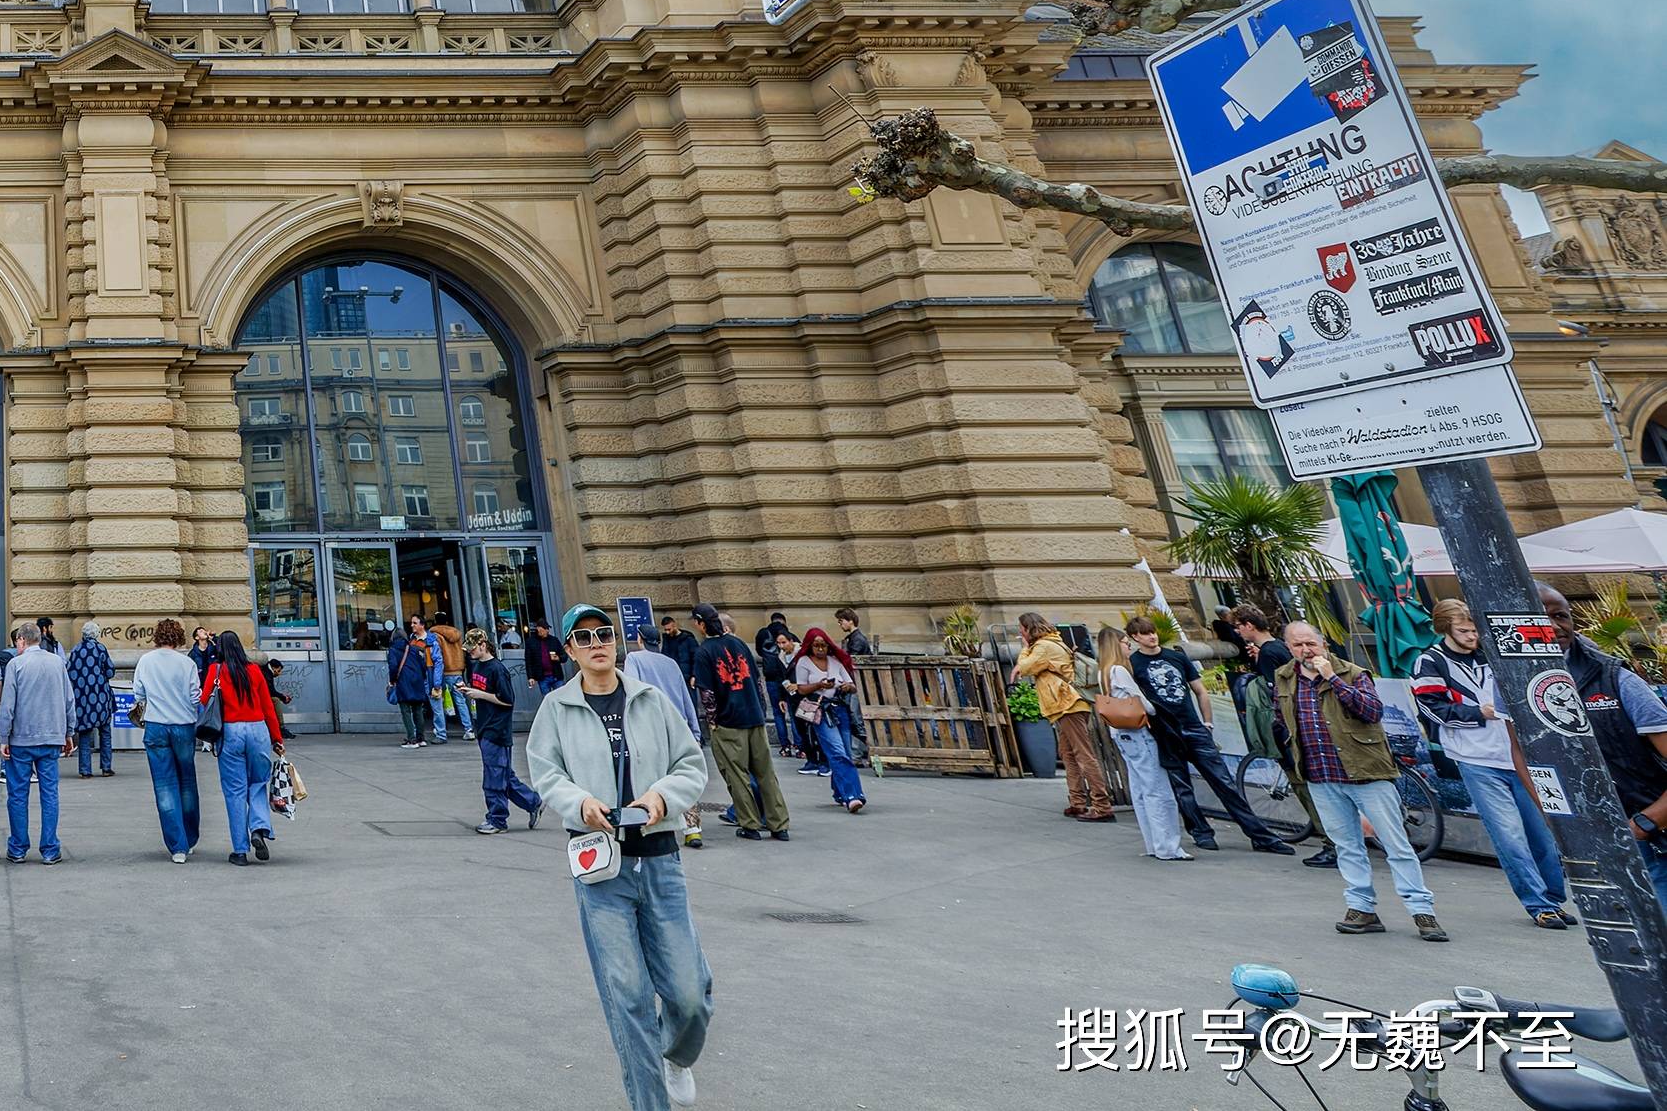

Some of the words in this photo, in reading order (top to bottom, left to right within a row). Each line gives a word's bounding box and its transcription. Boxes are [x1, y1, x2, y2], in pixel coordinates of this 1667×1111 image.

[1317, 39, 1354, 66] COMMANDO
[1282, 165, 1330, 194] CONTROL
[1285, 154, 1310, 177] STOP
[1335, 155, 1420, 201] EINTRACHT
[1390, 225, 1444, 254] Jahre
[1364, 261, 1414, 282] Binding
[1415, 250, 1453, 270] Szene
[1373, 273, 1464, 311] Frankfurt/Main
[1414, 316, 1492, 356] POLLUX
[1288, 430, 1302, 441] Die
[1302, 424, 1343, 438] Videokam
[1424, 404, 1461, 418] zielten
[1293, 442, 1318, 455] Suche
[1319, 438, 1339, 450] nach
[1439, 421, 1461, 433] Abs.
[1462, 417, 1469, 429] 9
[1471, 412, 1503, 428] HSOG
[1346, 424, 1428, 445] Waldstadion
[1299, 454, 1326, 468] mittels
[1466, 430, 1511, 445] werden.
[467, 514, 494, 529] Uddin
[494, 511, 502, 525] &
[502, 507, 533, 524] Uddin
[100, 626, 122, 641] ree
[125, 624, 154, 644] Cong
[1529, 769, 1552, 779] EGEN
[1542, 801, 1562, 812] ENA
[570, 840, 582, 852] LOVE
[581, 834, 605, 849] MOSCHINO
